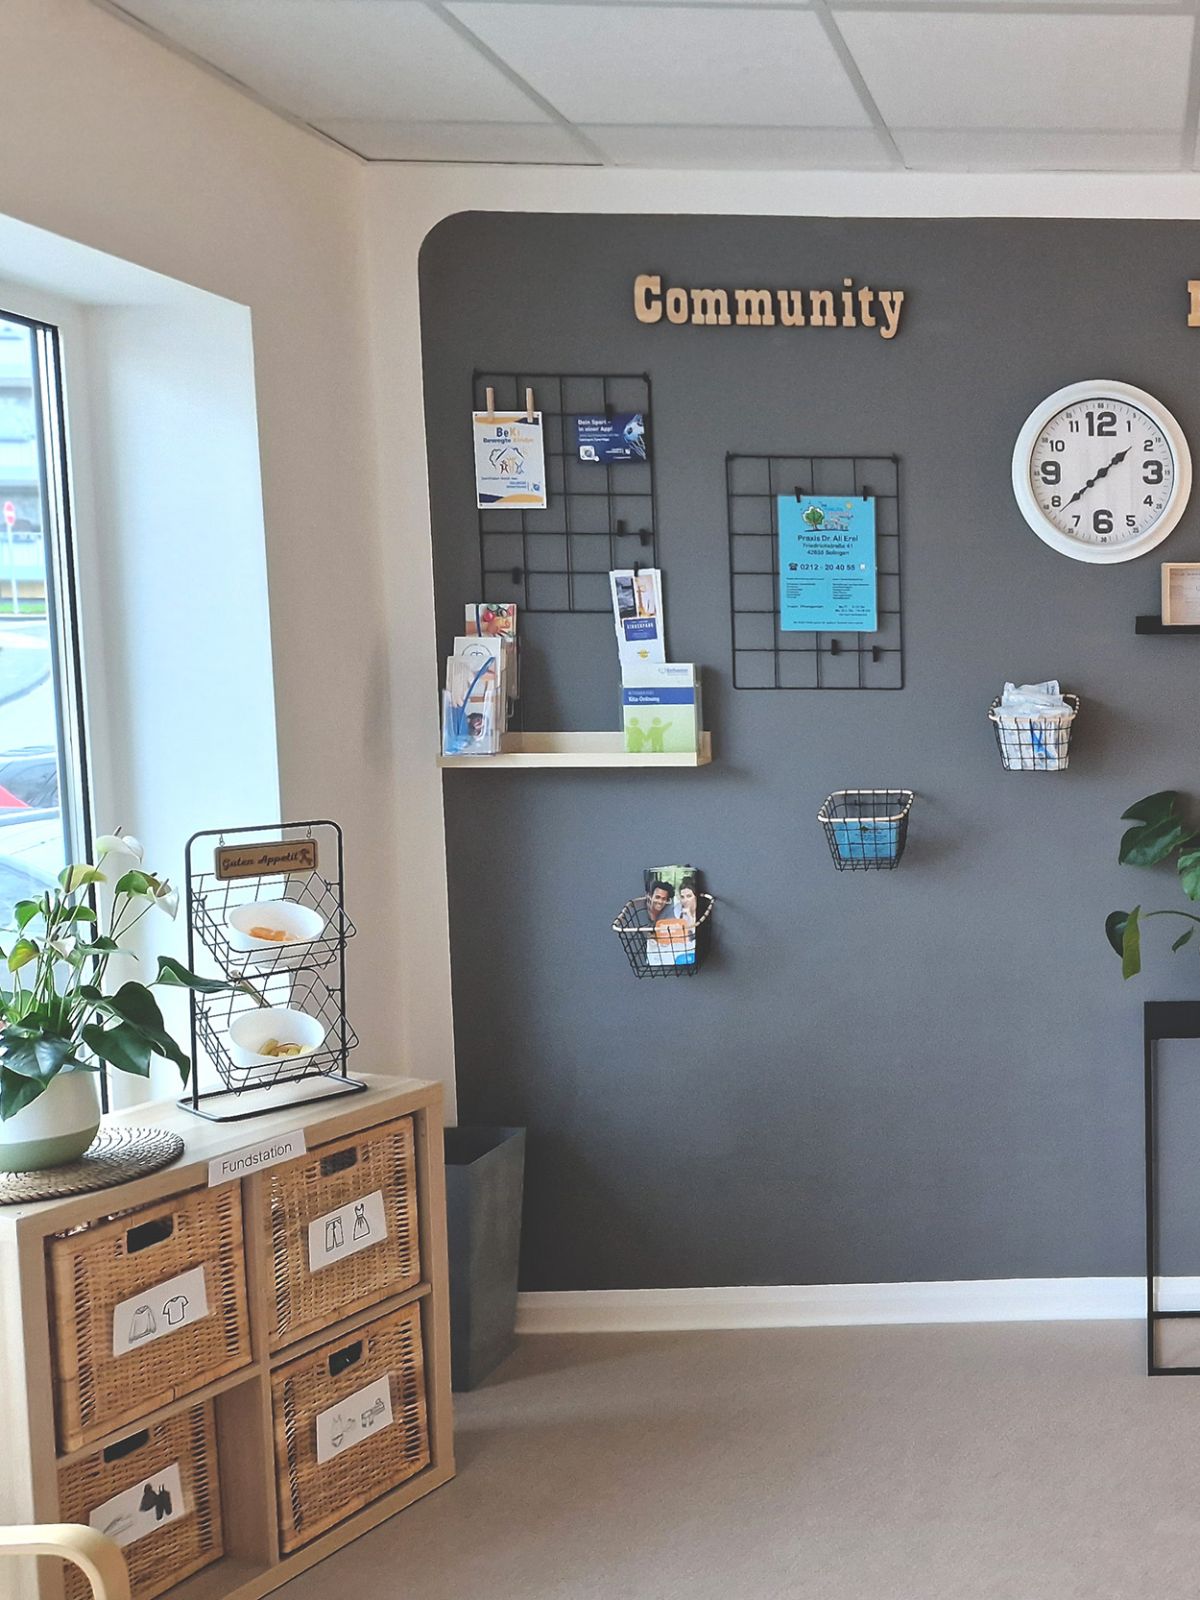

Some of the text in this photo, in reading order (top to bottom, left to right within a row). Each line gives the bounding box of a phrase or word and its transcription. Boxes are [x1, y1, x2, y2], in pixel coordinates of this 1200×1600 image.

[634, 274, 904, 338] Community
[1069, 420, 1079, 432] 11
[1085, 411, 1117, 436] 12
[1126, 420, 1131, 432] 1
[1050, 439, 1065, 452] 10
[1143, 439, 1154, 452] 2
[1040, 460, 1061, 485] 9
[1142, 460, 1163, 485] 3
[1051, 495, 1061, 507] 8
[1143, 495, 1153, 507] 4
[1072, 515, 1080, 527] 7
[1093, 509, 1113, 534] 6
[1126, 515, 1136, 527] 5
[222, 852, 298, 871] Guten Appetit
[221, 1143, 292, 1174] Fundstation
